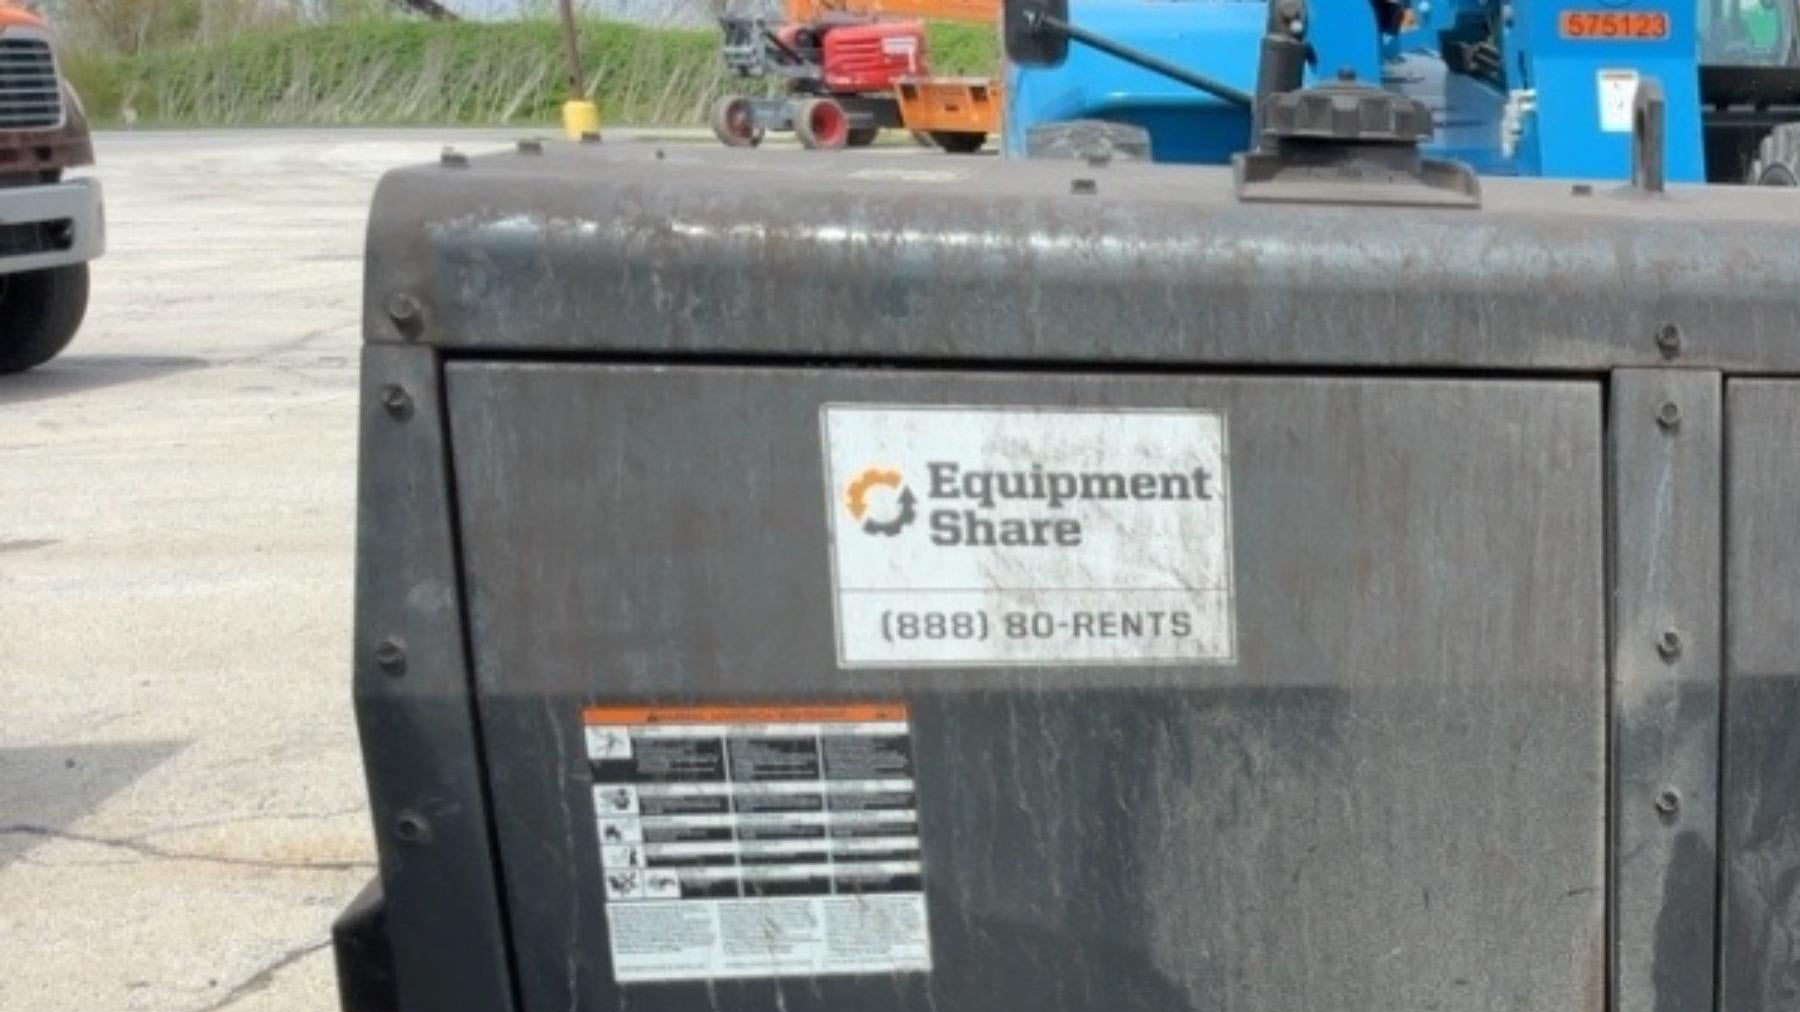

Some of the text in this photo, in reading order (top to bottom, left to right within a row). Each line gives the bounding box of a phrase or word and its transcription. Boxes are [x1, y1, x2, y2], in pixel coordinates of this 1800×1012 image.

[1567, 13, 1666, 37] 575123
[926, 461, 1213, 508] Equipment
[929, 509, 1083, 547] Share
[880, 611, 990, 640] (888)
